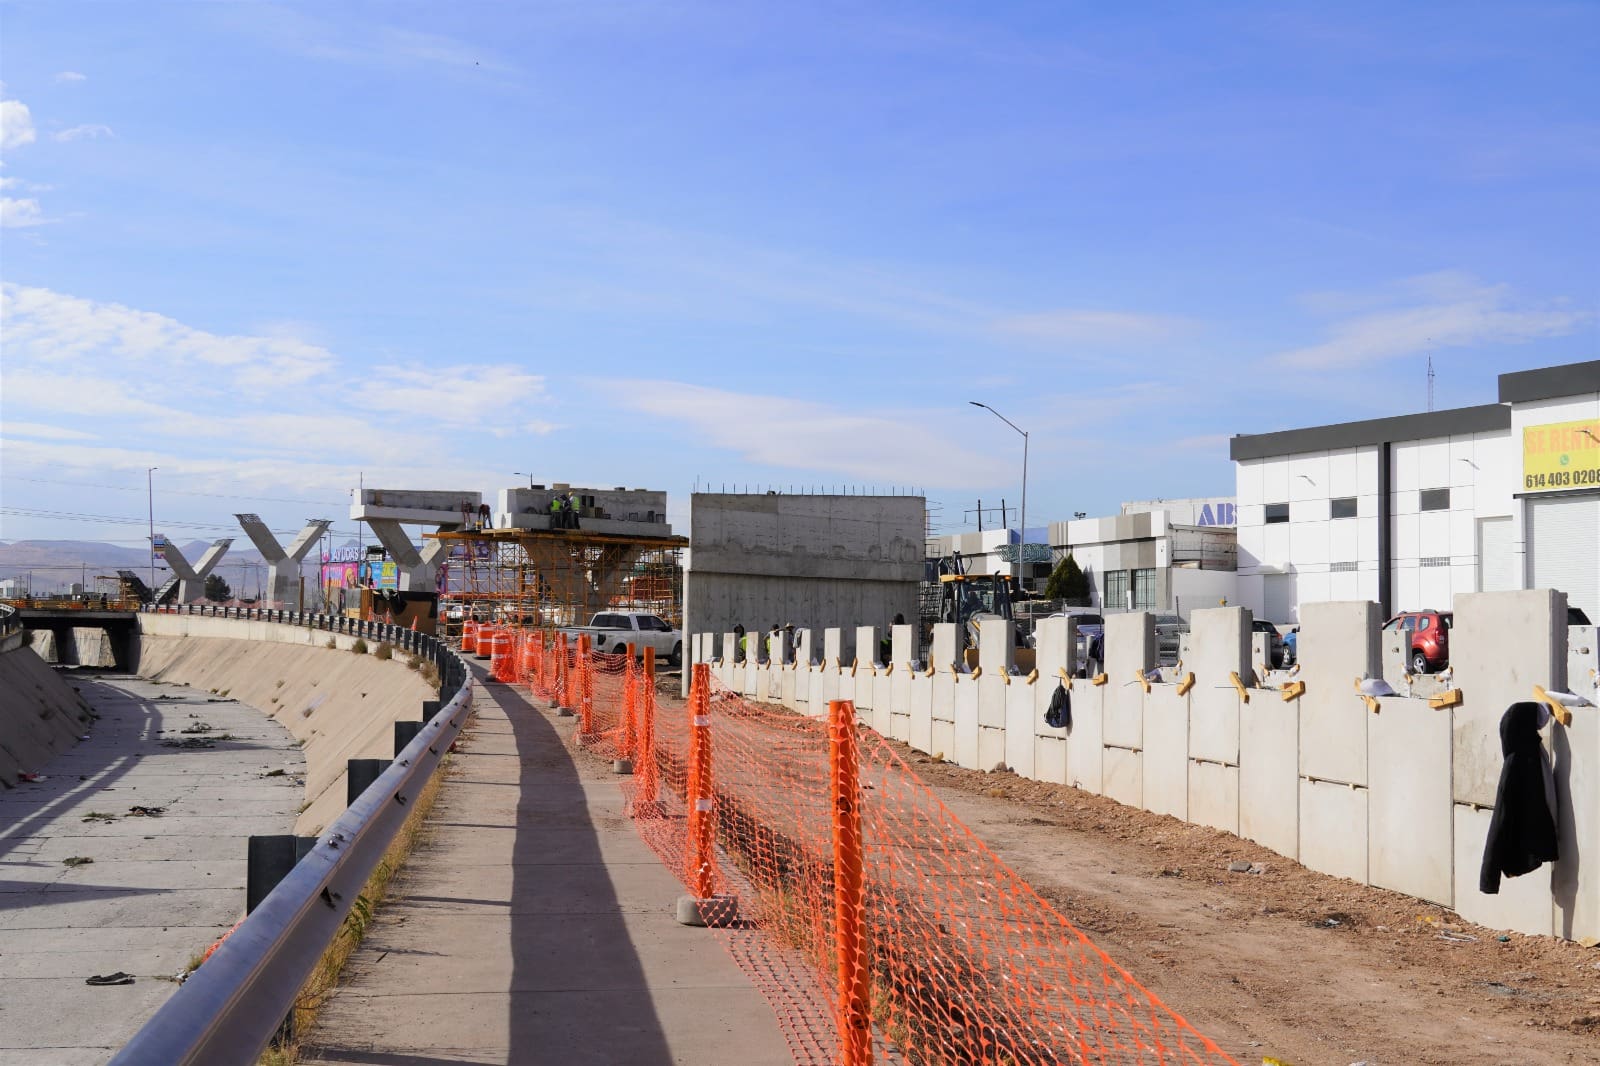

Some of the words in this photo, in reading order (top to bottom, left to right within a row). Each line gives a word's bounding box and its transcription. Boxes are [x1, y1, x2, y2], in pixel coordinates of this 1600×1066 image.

[1526, 430, 1545, 455] SE
[1526, 473, 1546, 488] 614
[1548, 471, 1570, 486] 403
[1197, 503, 1237, 526] AB
